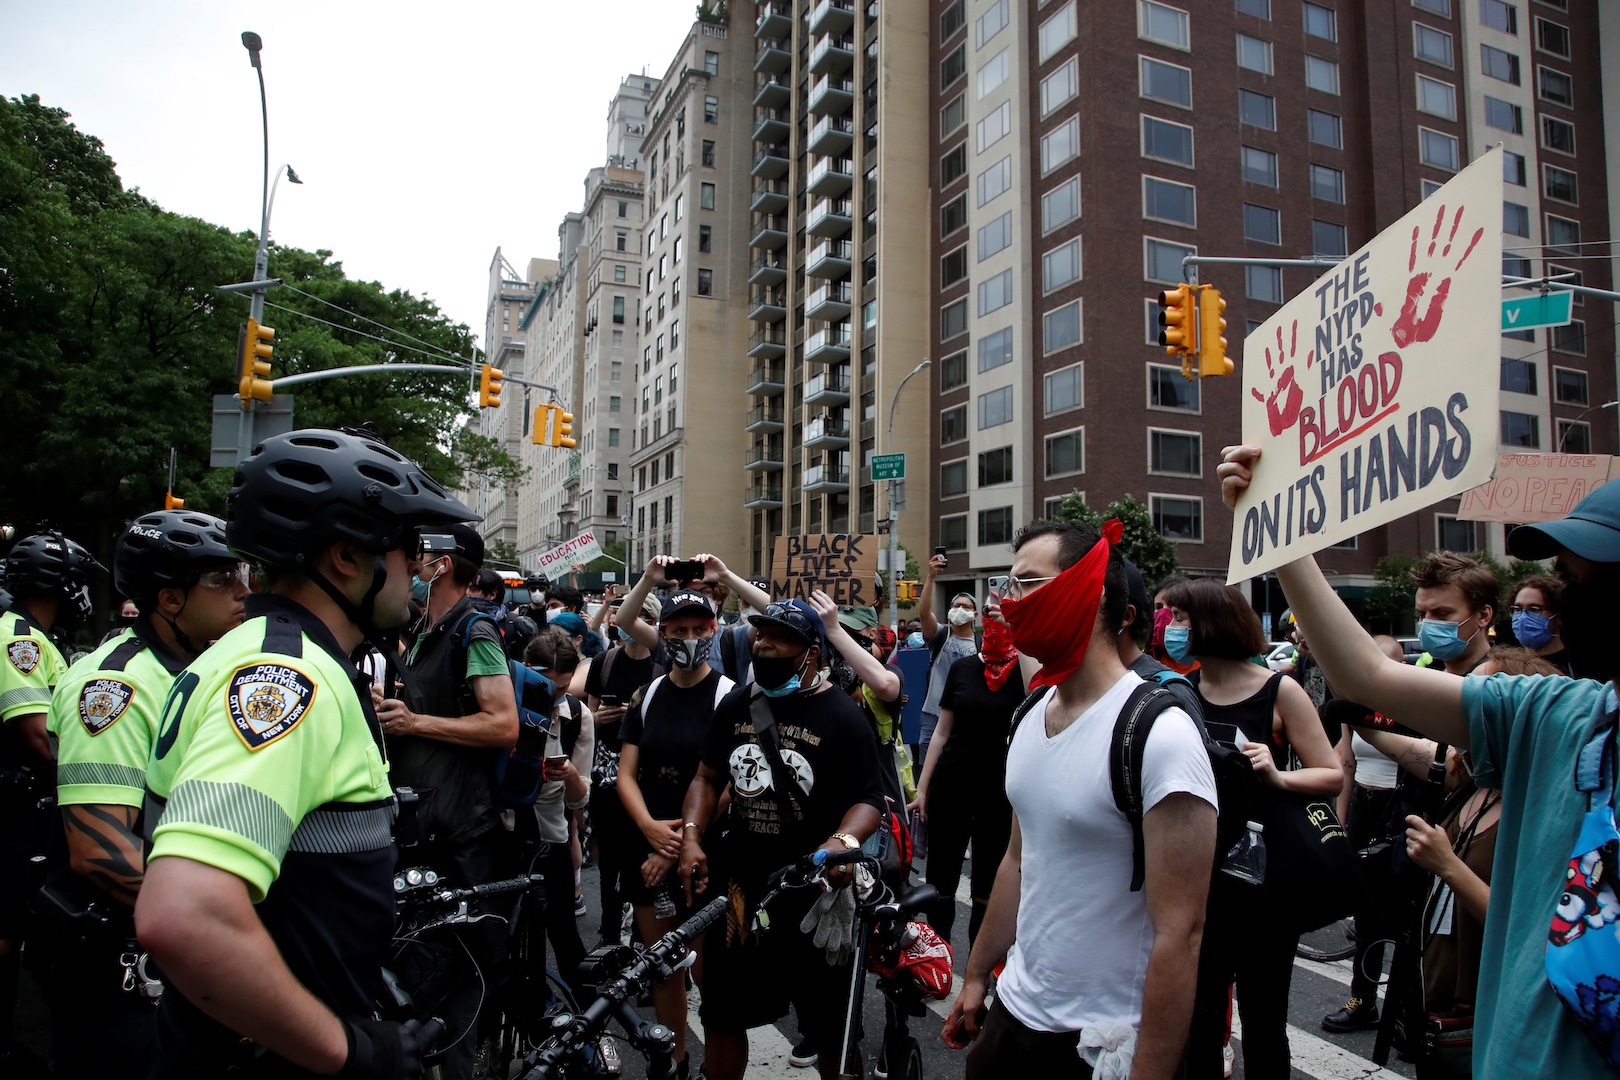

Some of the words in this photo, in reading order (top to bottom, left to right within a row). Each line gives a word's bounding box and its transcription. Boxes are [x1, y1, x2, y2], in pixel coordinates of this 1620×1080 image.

[1315, 251, 1370, 320] THE
[1315, 291, 1374, 363] NYPD
[1506, 308, 1521, 324] v
[1321, 332, 1363, 395] HAS
[1299, 351, 1403, 467] BLOOD
[873, 455, 904, 463] METROPOLITAN
[1500, 455, 1596, 468] JUSTICE
[1241, 493, 1281, 565] ON
[1285, 464, 1327, 546] ITS
[1340, 392, 1471, 523] HANDS
[128, 525, 163, 540] POLICE
[540, 532, 595, 567] EDUCATION
[788, 535, 864, 557] BLACK
[786, 555, 858, 577] LIVES
[773, 577, 866, 606] MATTER
[95, 680, 122, 690] POLICE
[255, 665, 298, 681] POLICE
[83, 685, 130, 699] DEPARTMENT
[234, 674, 309, 698] DEPARTMENT
[230, 694, 241, 716] CITY
[236, 718, 250, 731] OF
[261, 724, 284, 740] NEW
[283, 703, 305, 726] YORK
